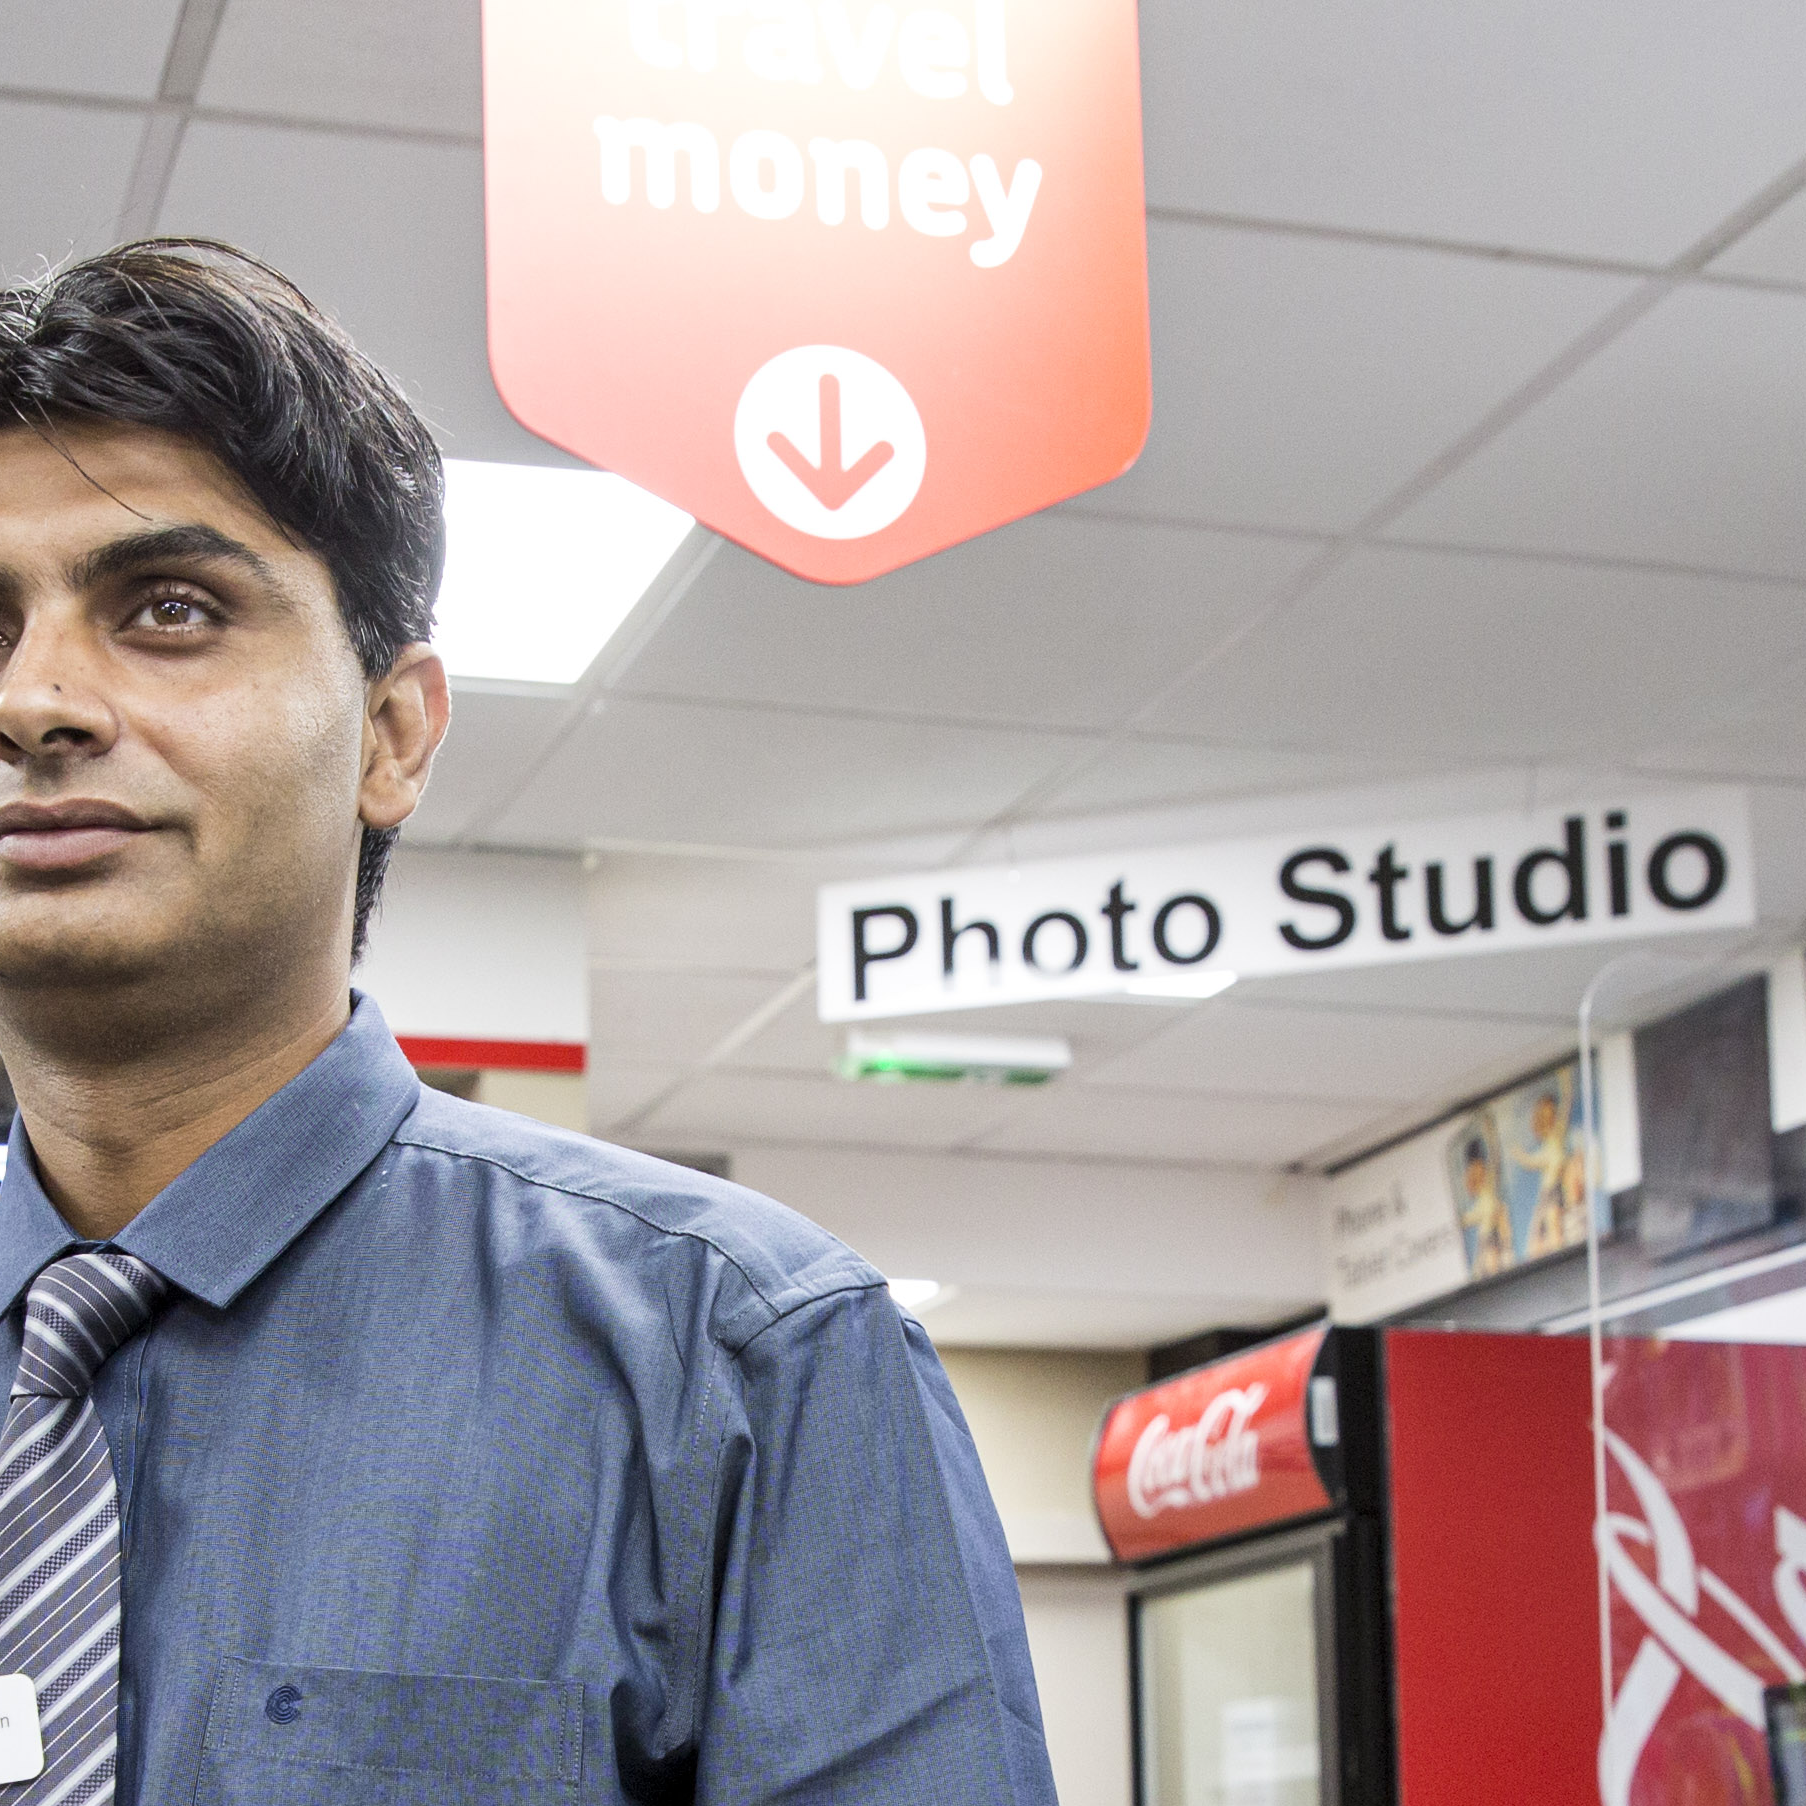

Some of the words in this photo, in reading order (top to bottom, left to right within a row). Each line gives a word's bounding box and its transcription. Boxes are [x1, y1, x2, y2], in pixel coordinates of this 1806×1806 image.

[593, 115, 1043, 269] money
[849, 875, 1222, 1003] Photo
[1277, 809, 1729, 955] Studio
